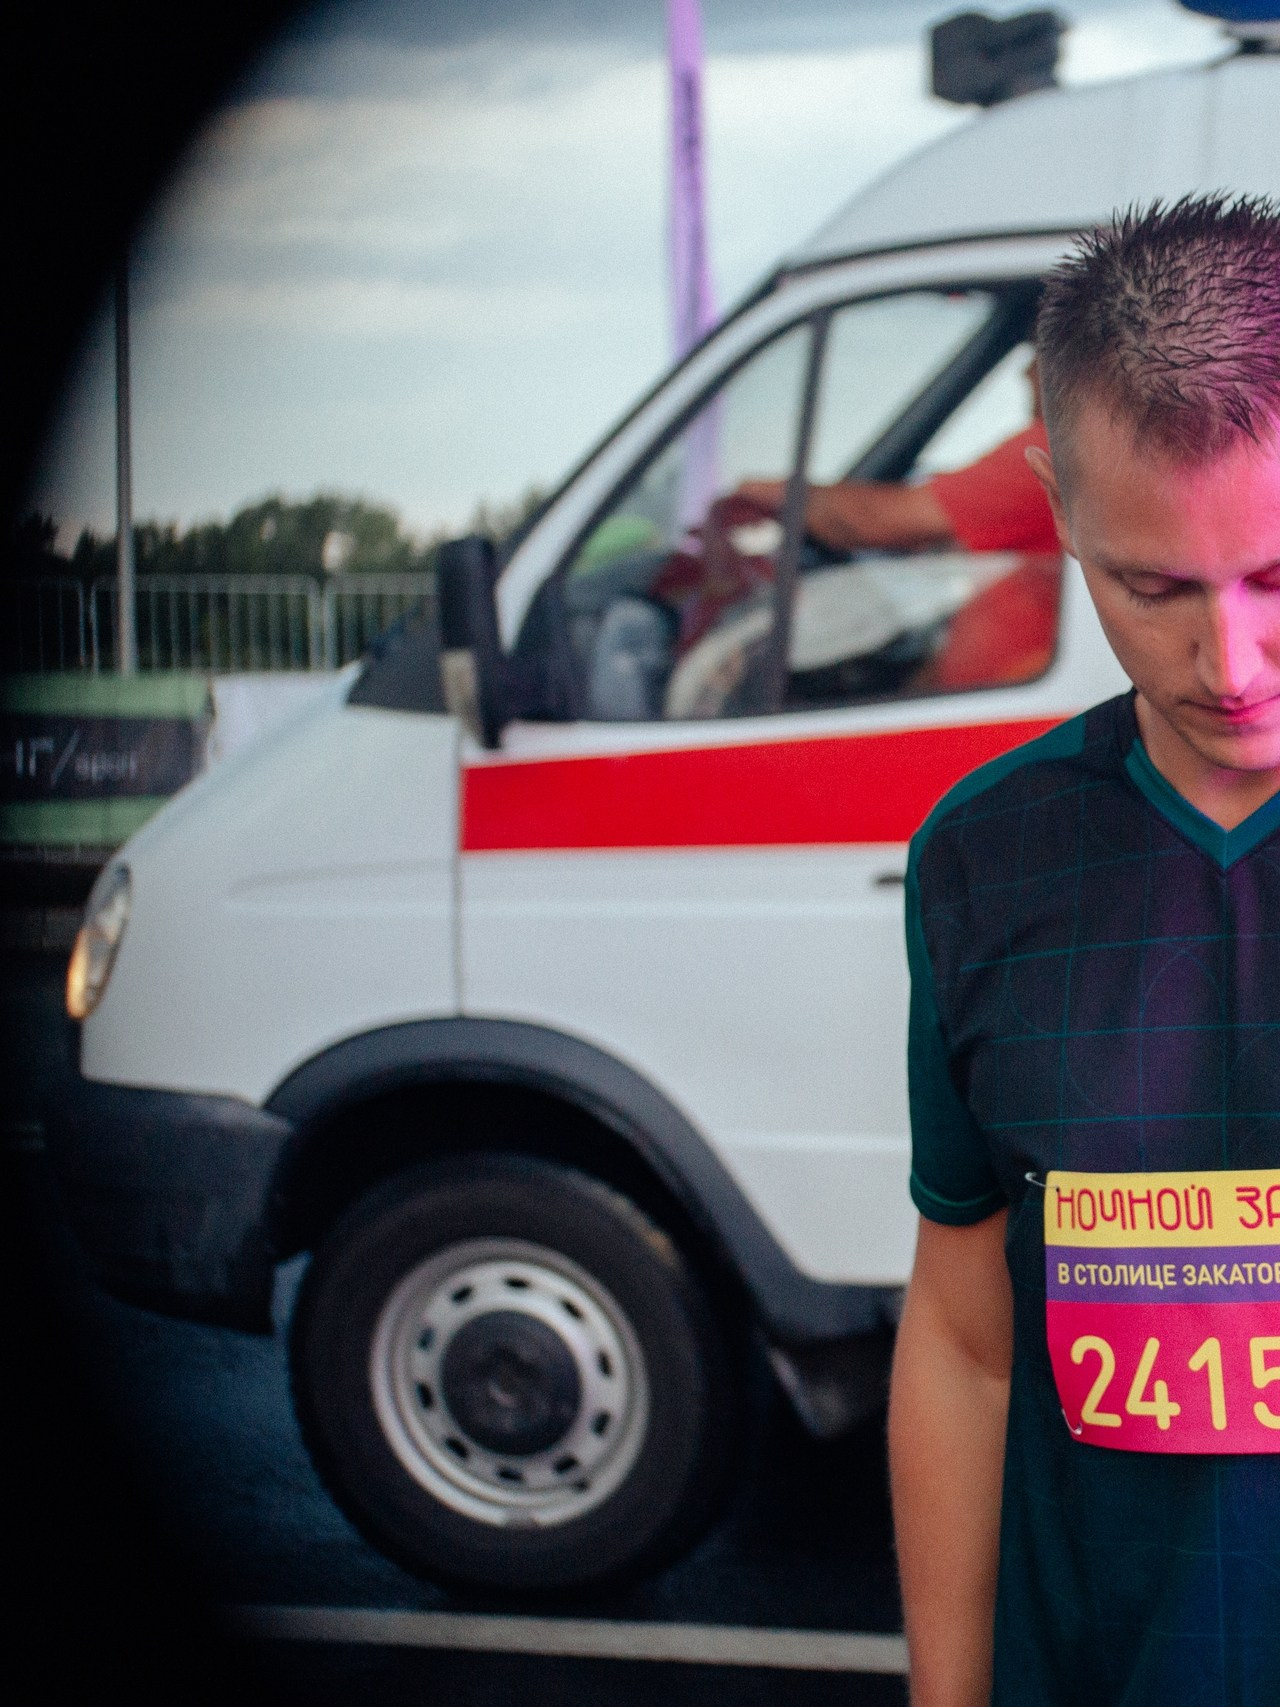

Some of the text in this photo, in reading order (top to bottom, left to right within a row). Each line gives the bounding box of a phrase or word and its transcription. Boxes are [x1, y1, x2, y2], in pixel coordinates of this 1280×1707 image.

[1056, 1184, 1214, 1231] НОЧНОЙ
[1058, 1263, 1071, 1285] В
[1073, 1263, 1177, 1290] СТОЛИЦЕ
